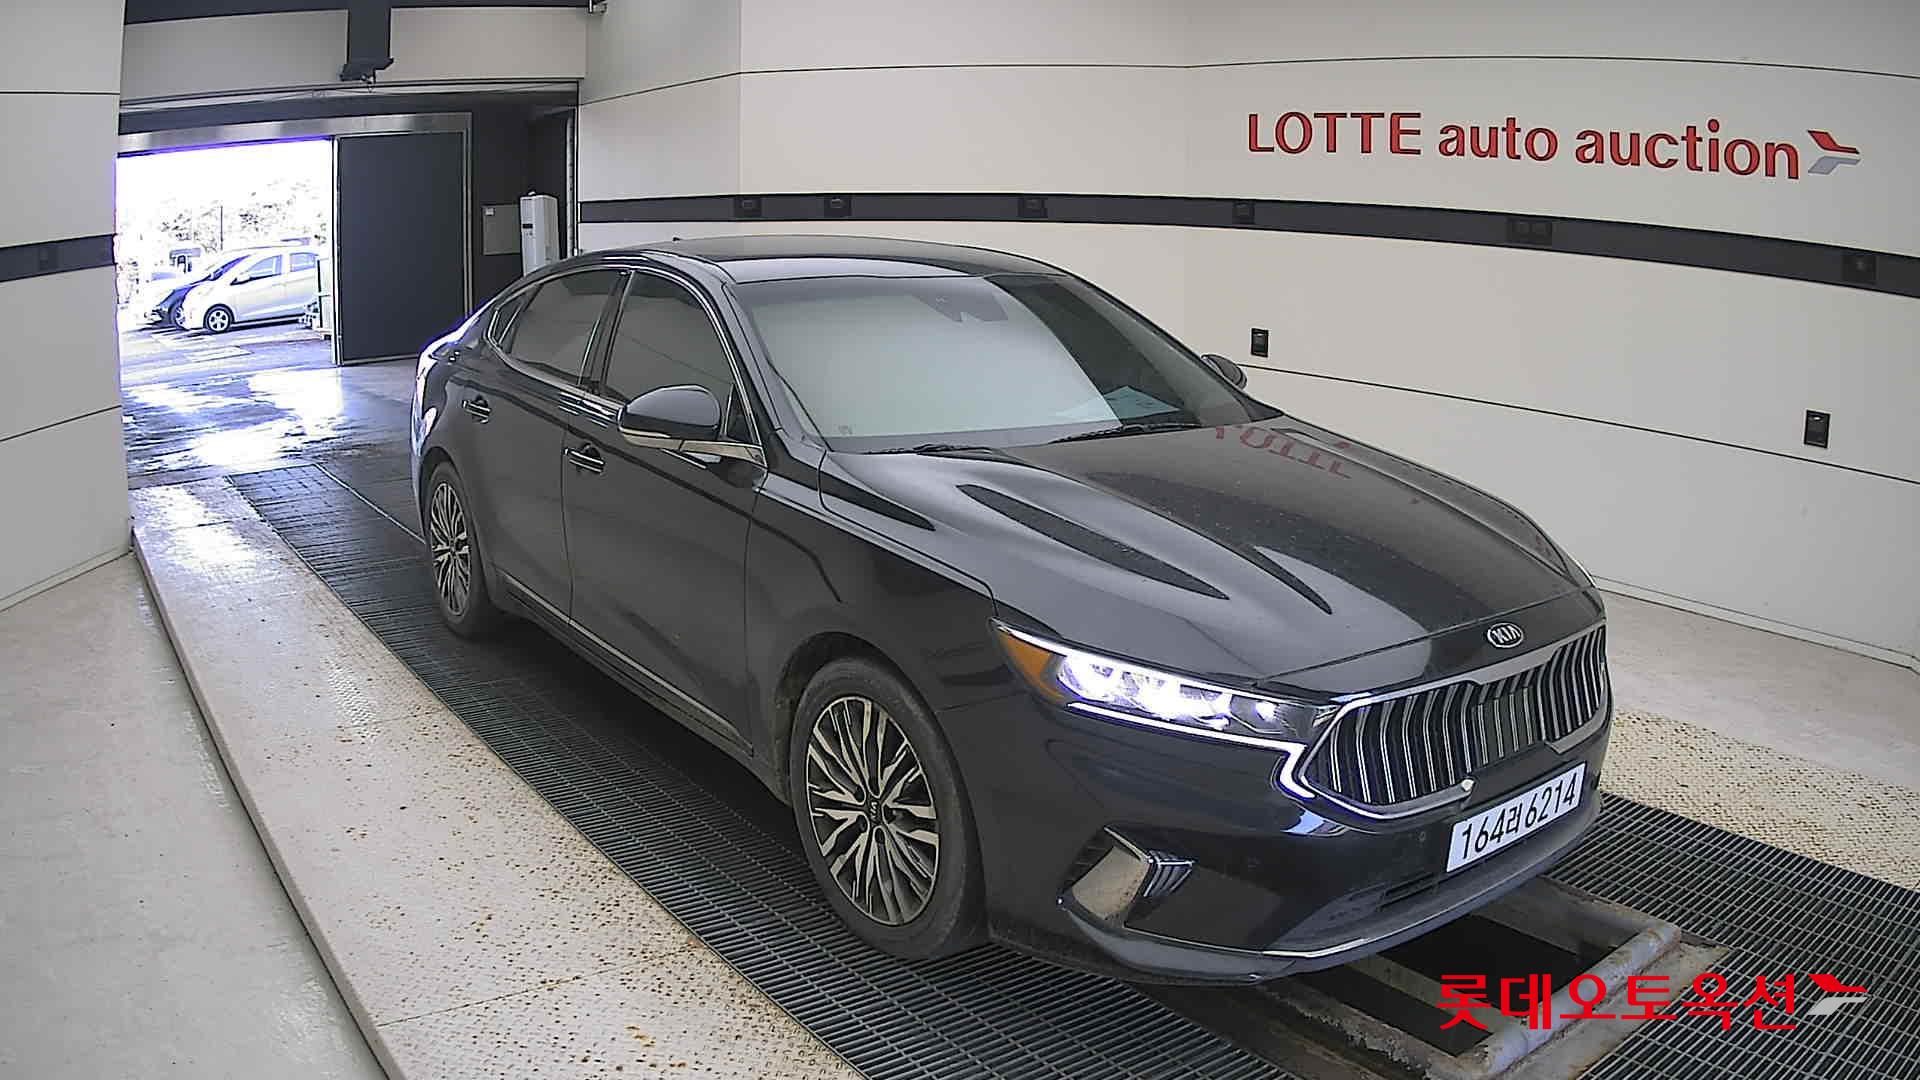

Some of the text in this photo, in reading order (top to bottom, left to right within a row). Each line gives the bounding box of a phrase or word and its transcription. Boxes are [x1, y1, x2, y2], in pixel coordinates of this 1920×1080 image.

[1247, 112, 1800, 179] LOTTE auto auction
[1490, 624, 1521, 645] KIA
